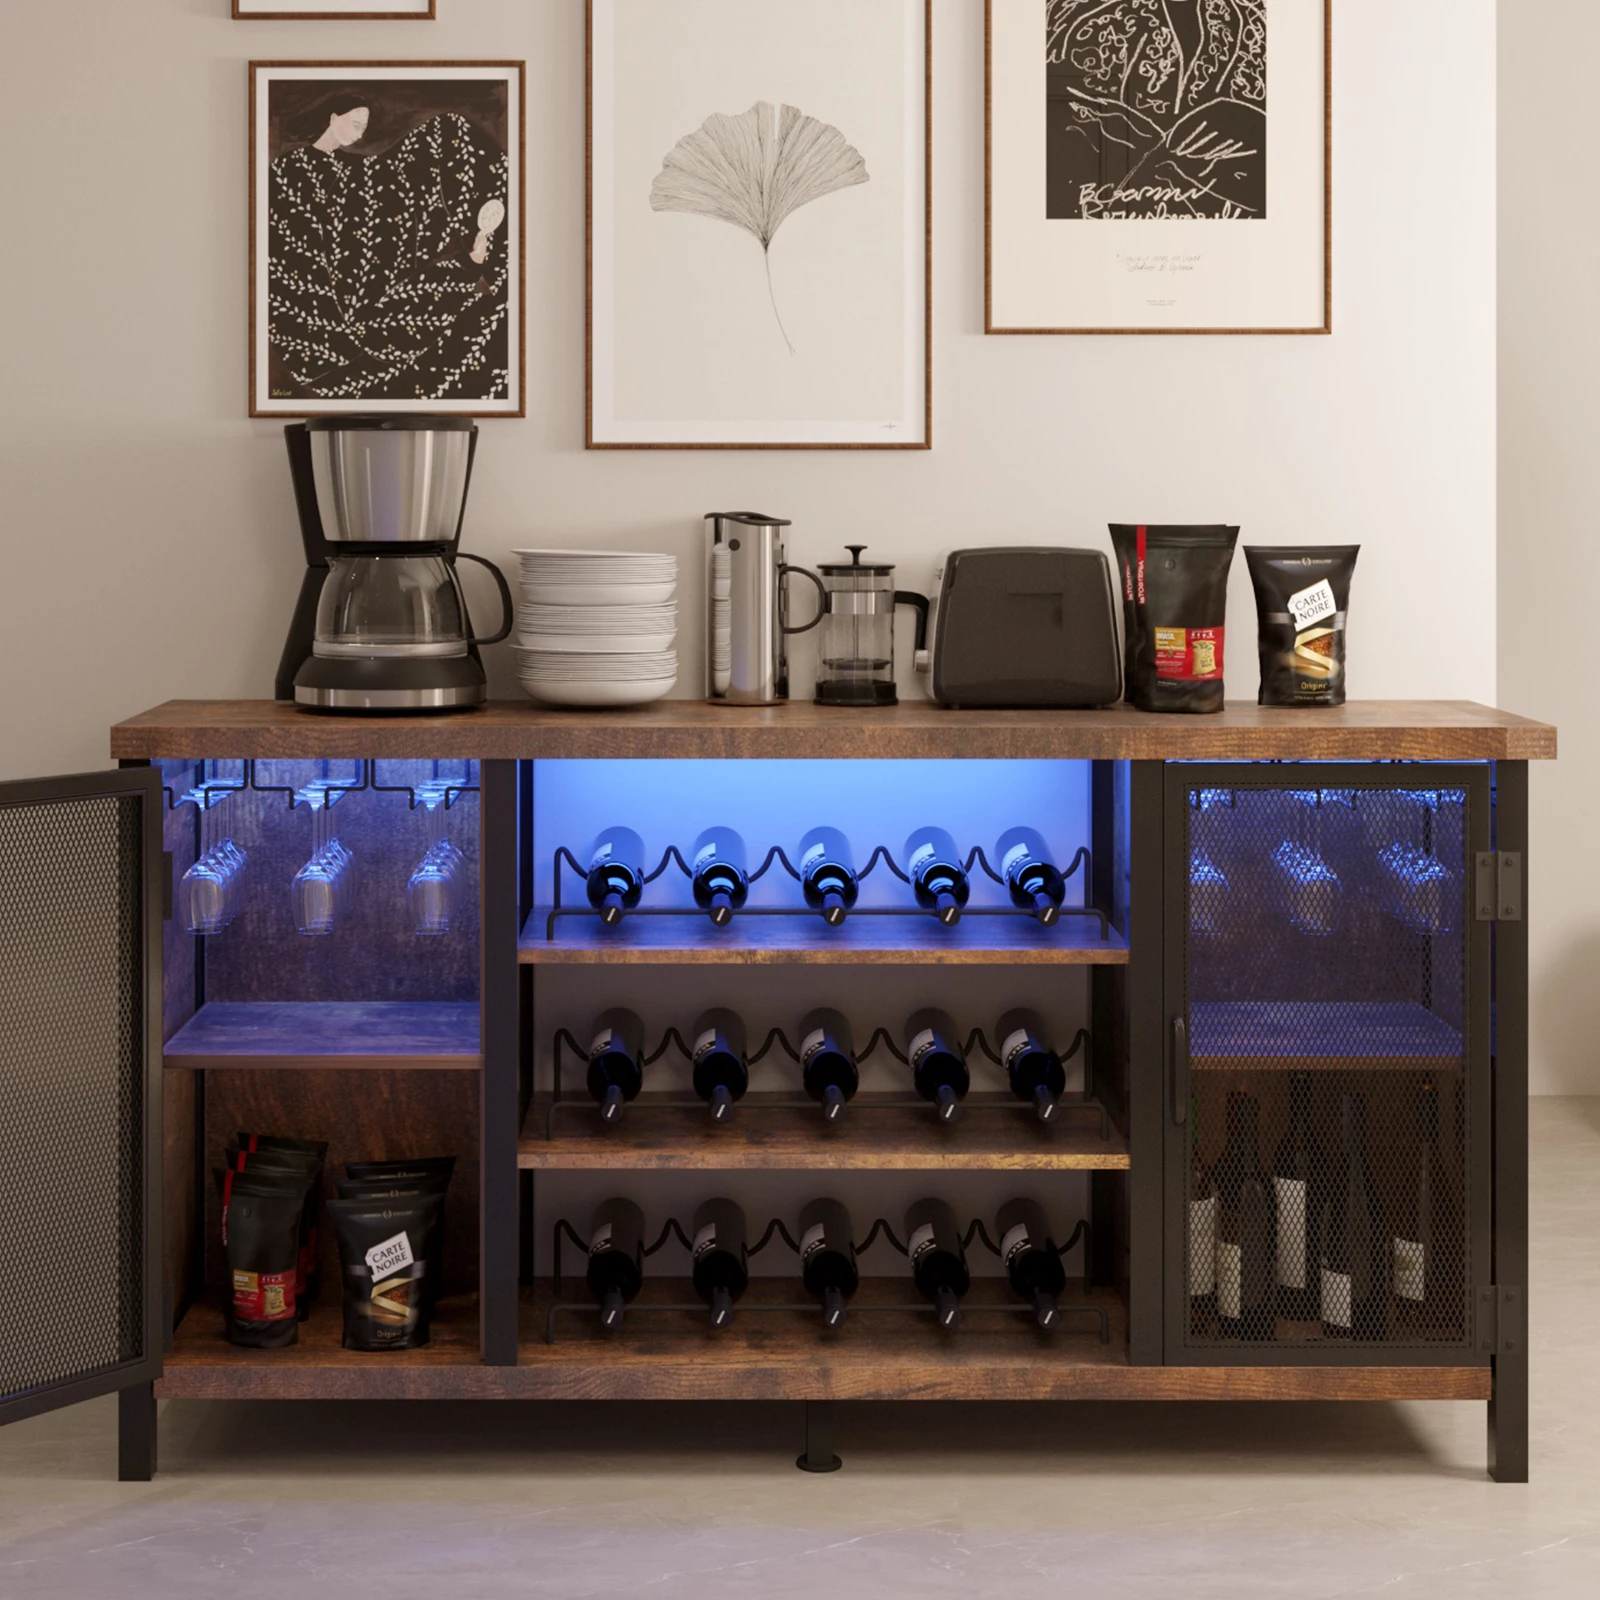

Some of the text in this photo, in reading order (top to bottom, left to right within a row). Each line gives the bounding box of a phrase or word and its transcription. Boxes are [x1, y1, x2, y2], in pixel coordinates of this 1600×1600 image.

[1295, 589, 1328, 611] CARTE
[1300, 600, 1331, 621] NOIRE
[371, 1241, 405, 1264] CARTE
[376, 1251, 408, 1274] NOIRE
